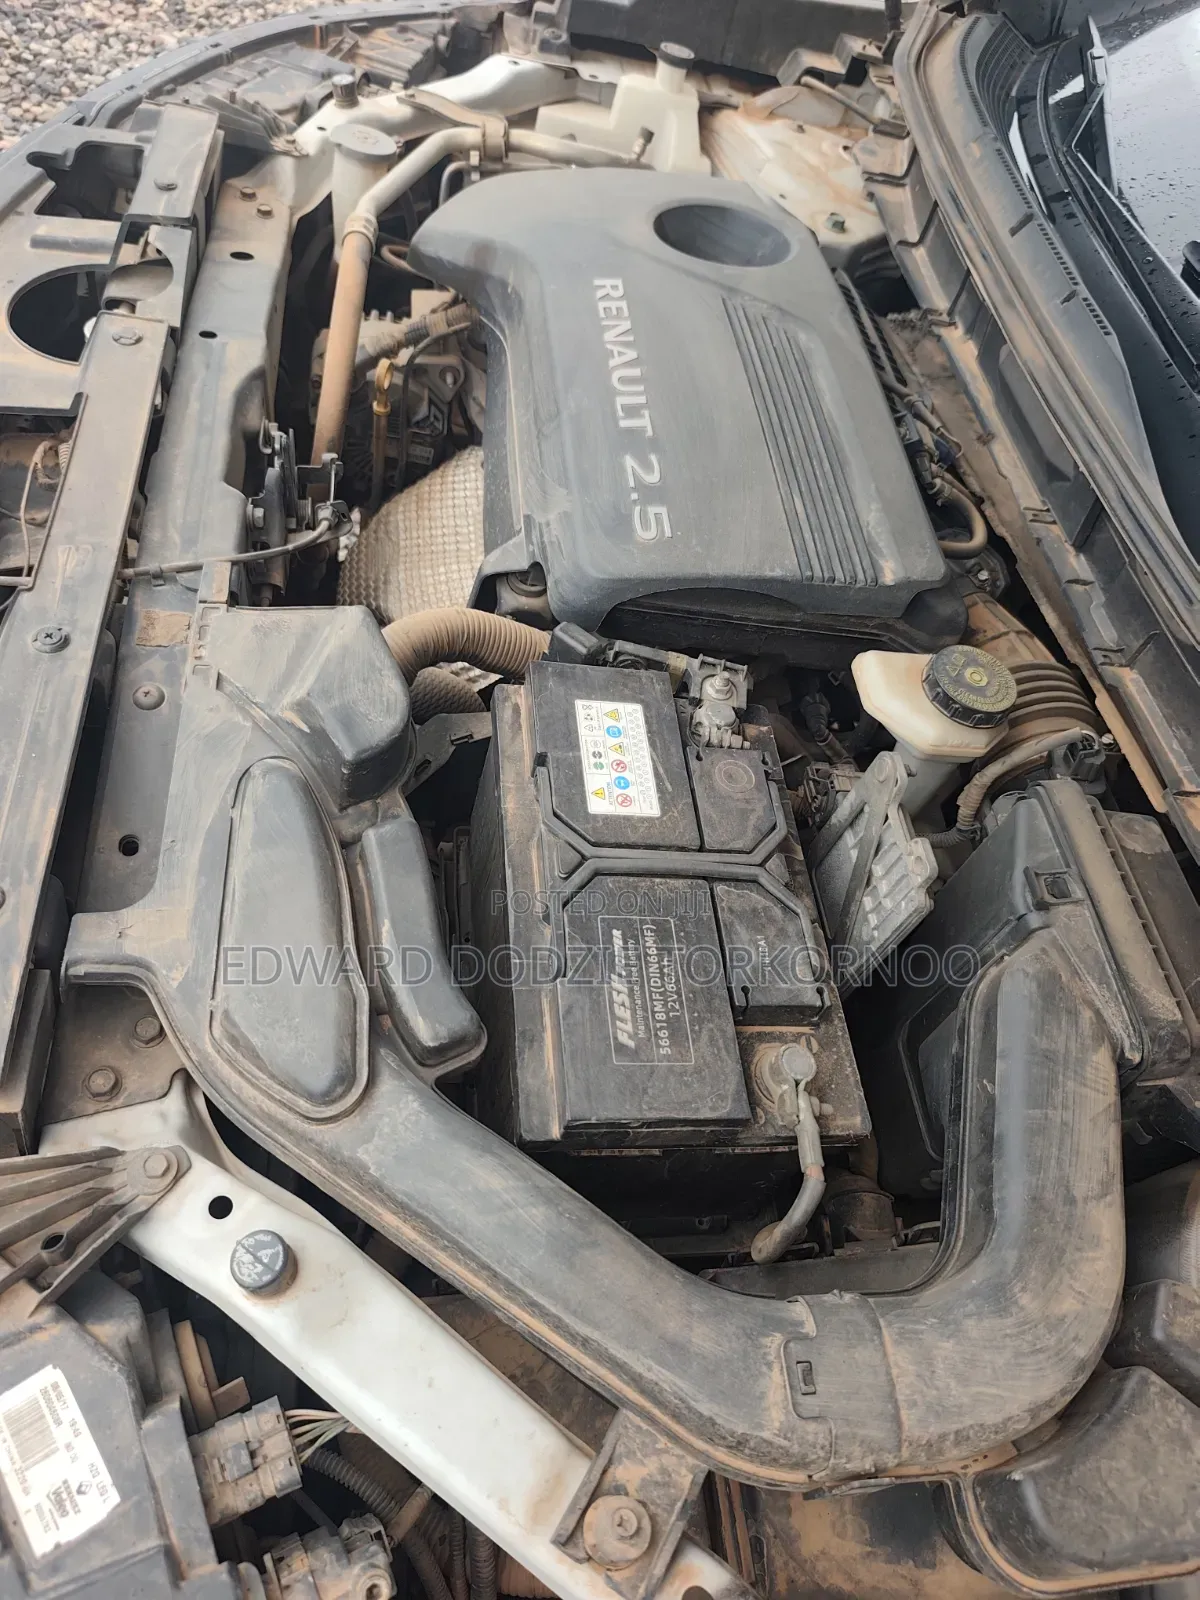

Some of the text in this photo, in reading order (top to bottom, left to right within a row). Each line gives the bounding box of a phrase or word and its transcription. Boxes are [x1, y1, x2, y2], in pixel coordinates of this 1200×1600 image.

[593, 277, 673, 542] RENAULT 2.5
[643, 924, 672, 1055] 56618MF(DIN66MF)
[661, 957, 681, 1018] 12V66Ah
